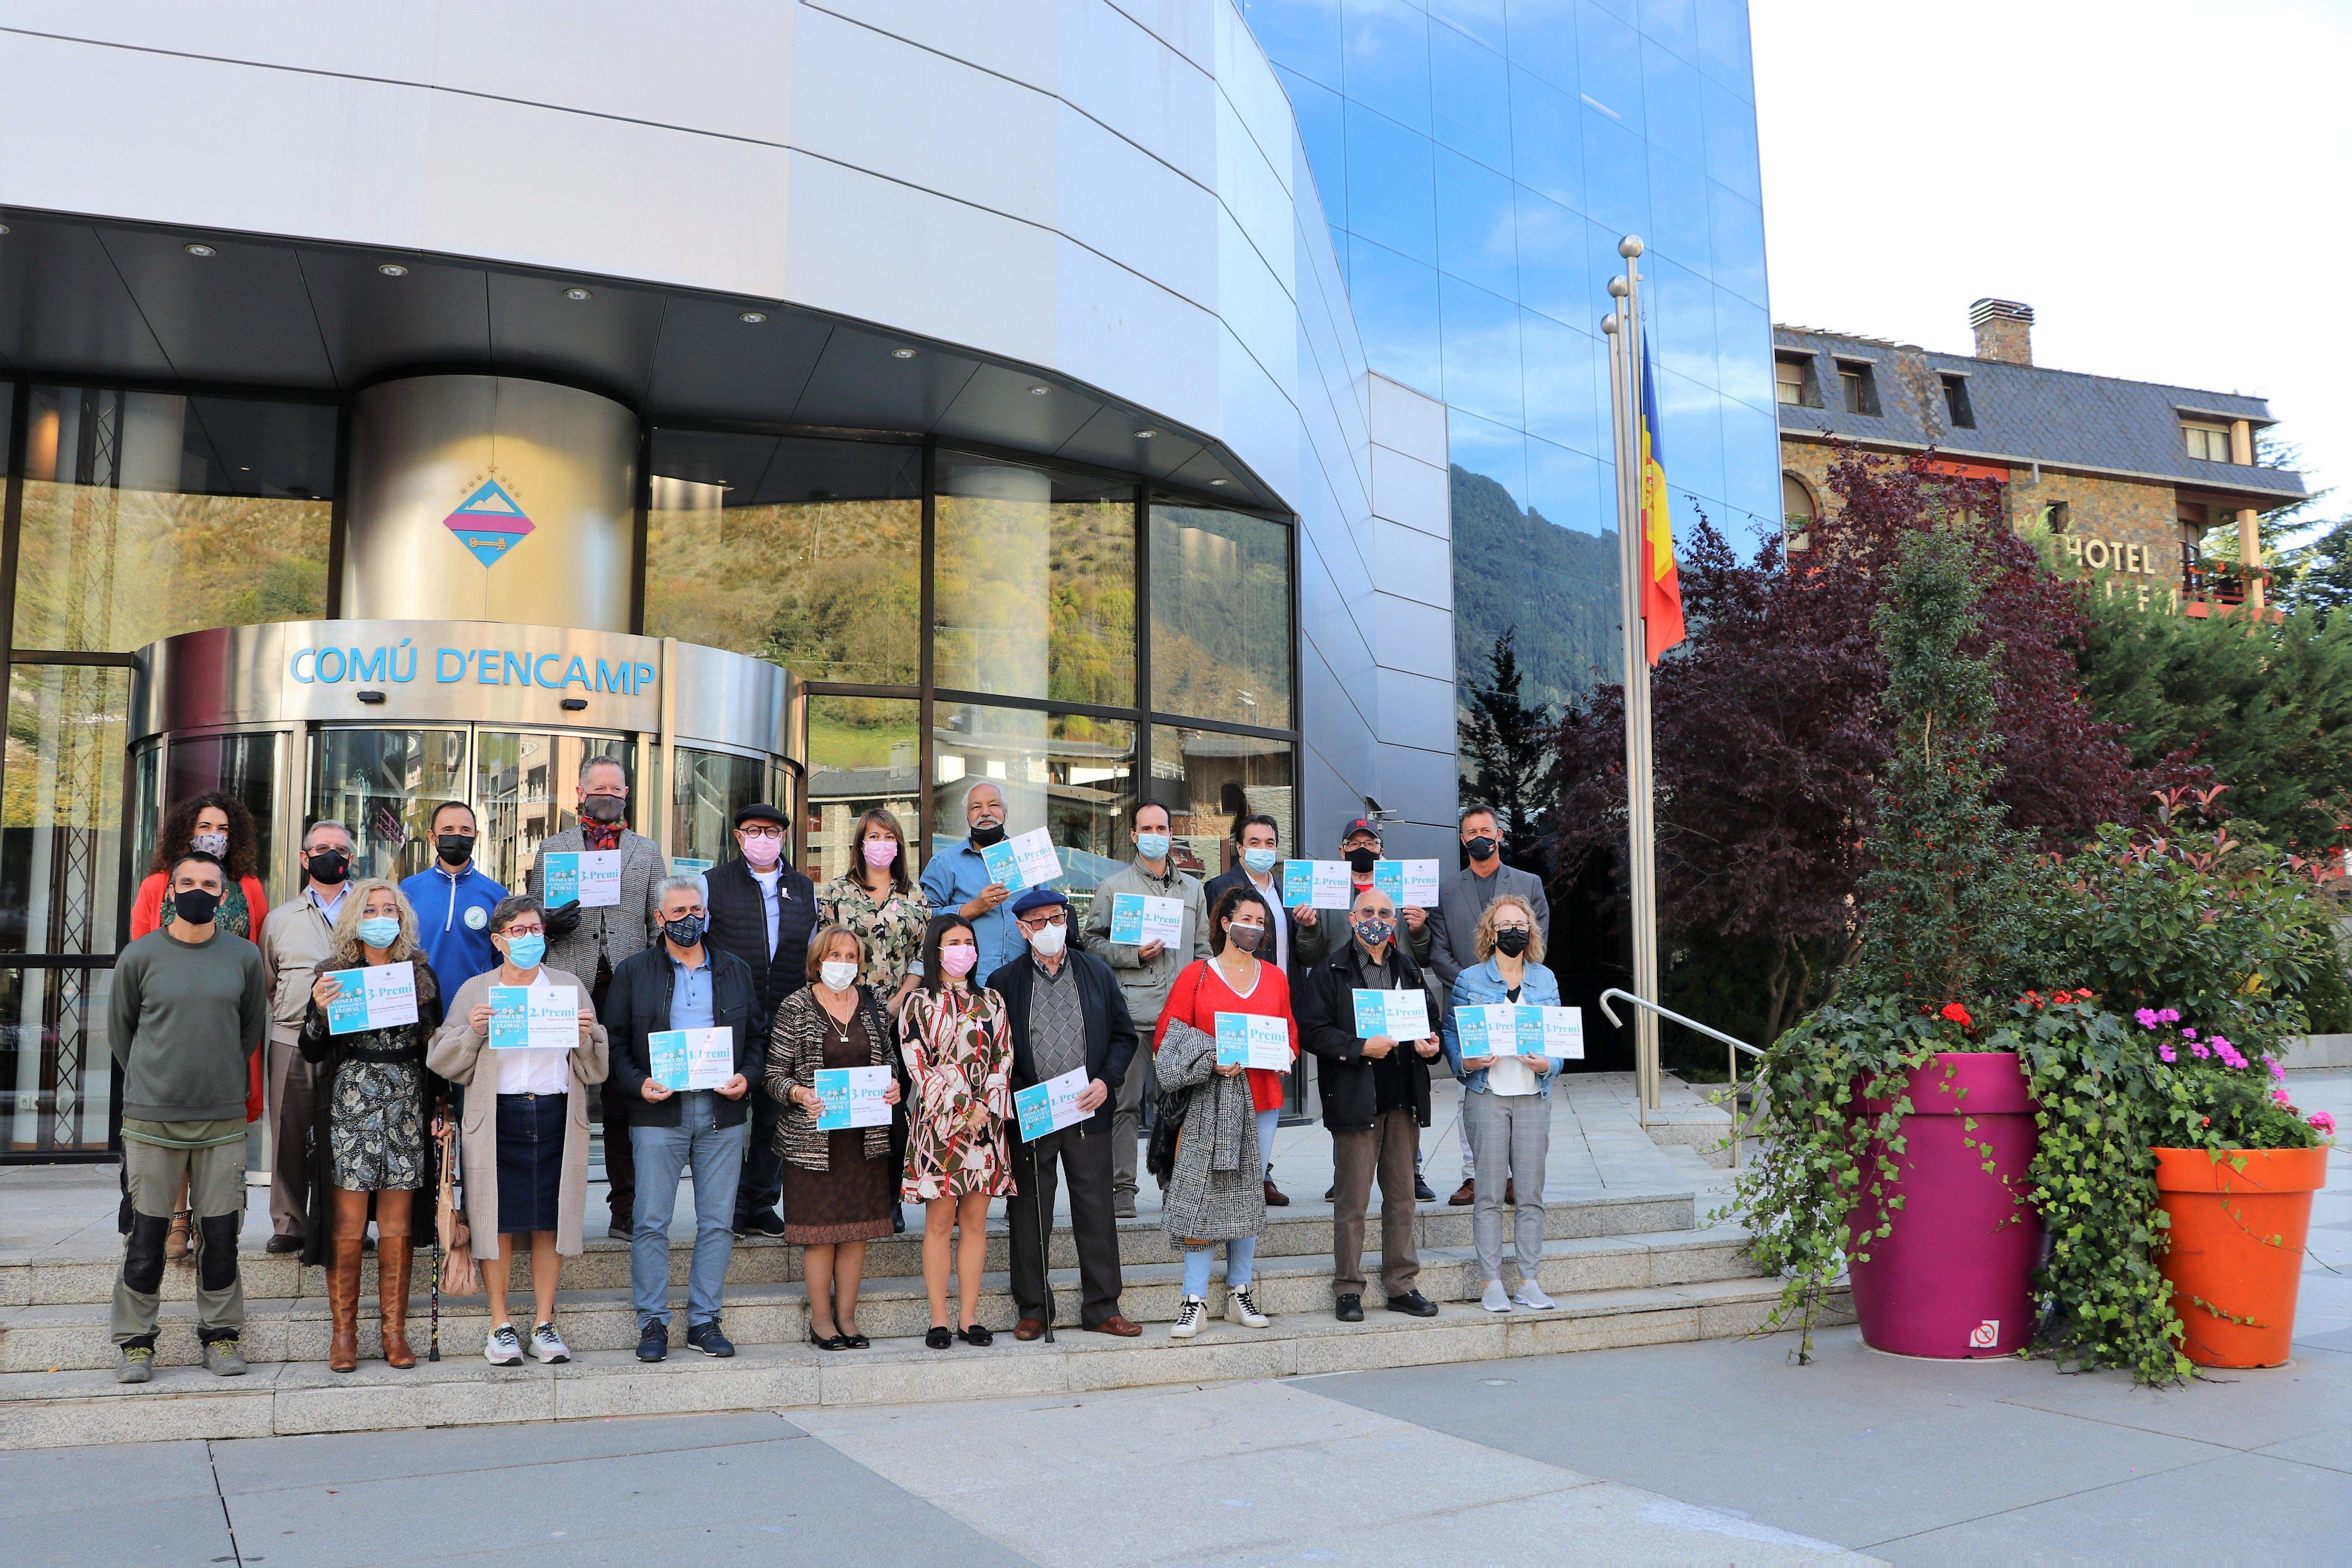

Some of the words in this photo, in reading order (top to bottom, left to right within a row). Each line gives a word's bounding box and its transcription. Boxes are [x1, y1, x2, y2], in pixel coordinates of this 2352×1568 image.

[2066, 535, 2156, 575] HOTEL
[290, 638, 417, 683] COMÚ
[436, 649, 657, 695] D'ENCAMP
[1023, 844, 1052, 861] Premi
[590, 869, 618, 879] Premi
[1322, 877, 1348, 886] Premi
[1412, 876, 1436, 884] Premi
[1153, 914, 1180, 924] Premi
[378, 983, 412, 997] Premi
[335, 1006, 359, 1014] FLORAL
[541, 1007, 575, 1017] Premi
[1395, 1007, 1425, 1016] Premi
[1553, 1024, 1580, 1033] Premi
[1250, 1028, 1285, 1042] Premi
[699, 1047, 730, 1059] Premi
[861, 1086, 889, 1097] Prem
